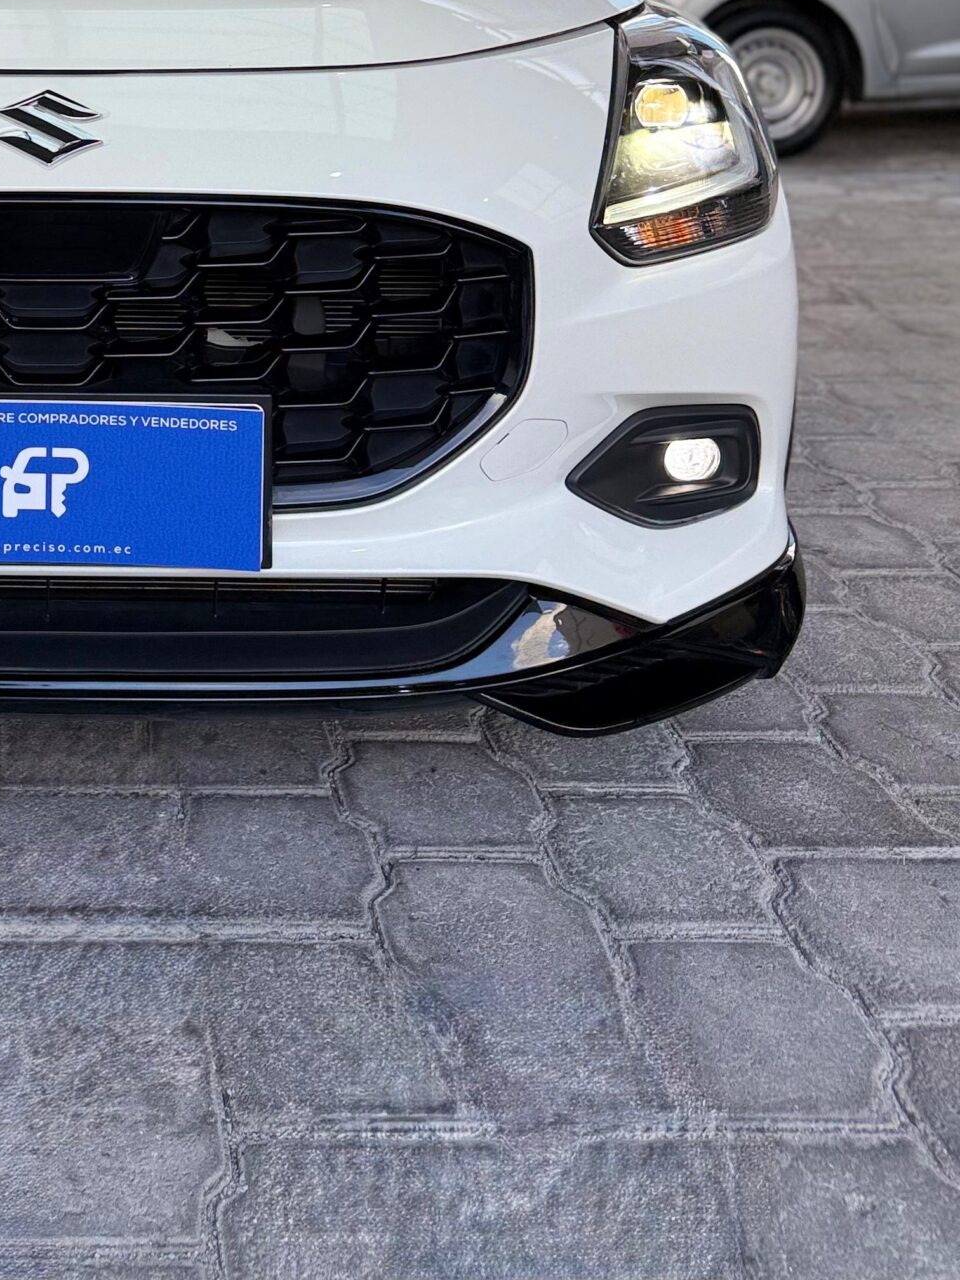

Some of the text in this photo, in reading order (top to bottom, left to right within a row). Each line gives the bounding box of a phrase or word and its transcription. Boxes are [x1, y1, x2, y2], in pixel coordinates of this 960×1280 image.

[18, 412, 127, 426] COMPRADORES
[129, 415, 139, 426] Y
[141, 416, 238, 431] VENDEDORES
